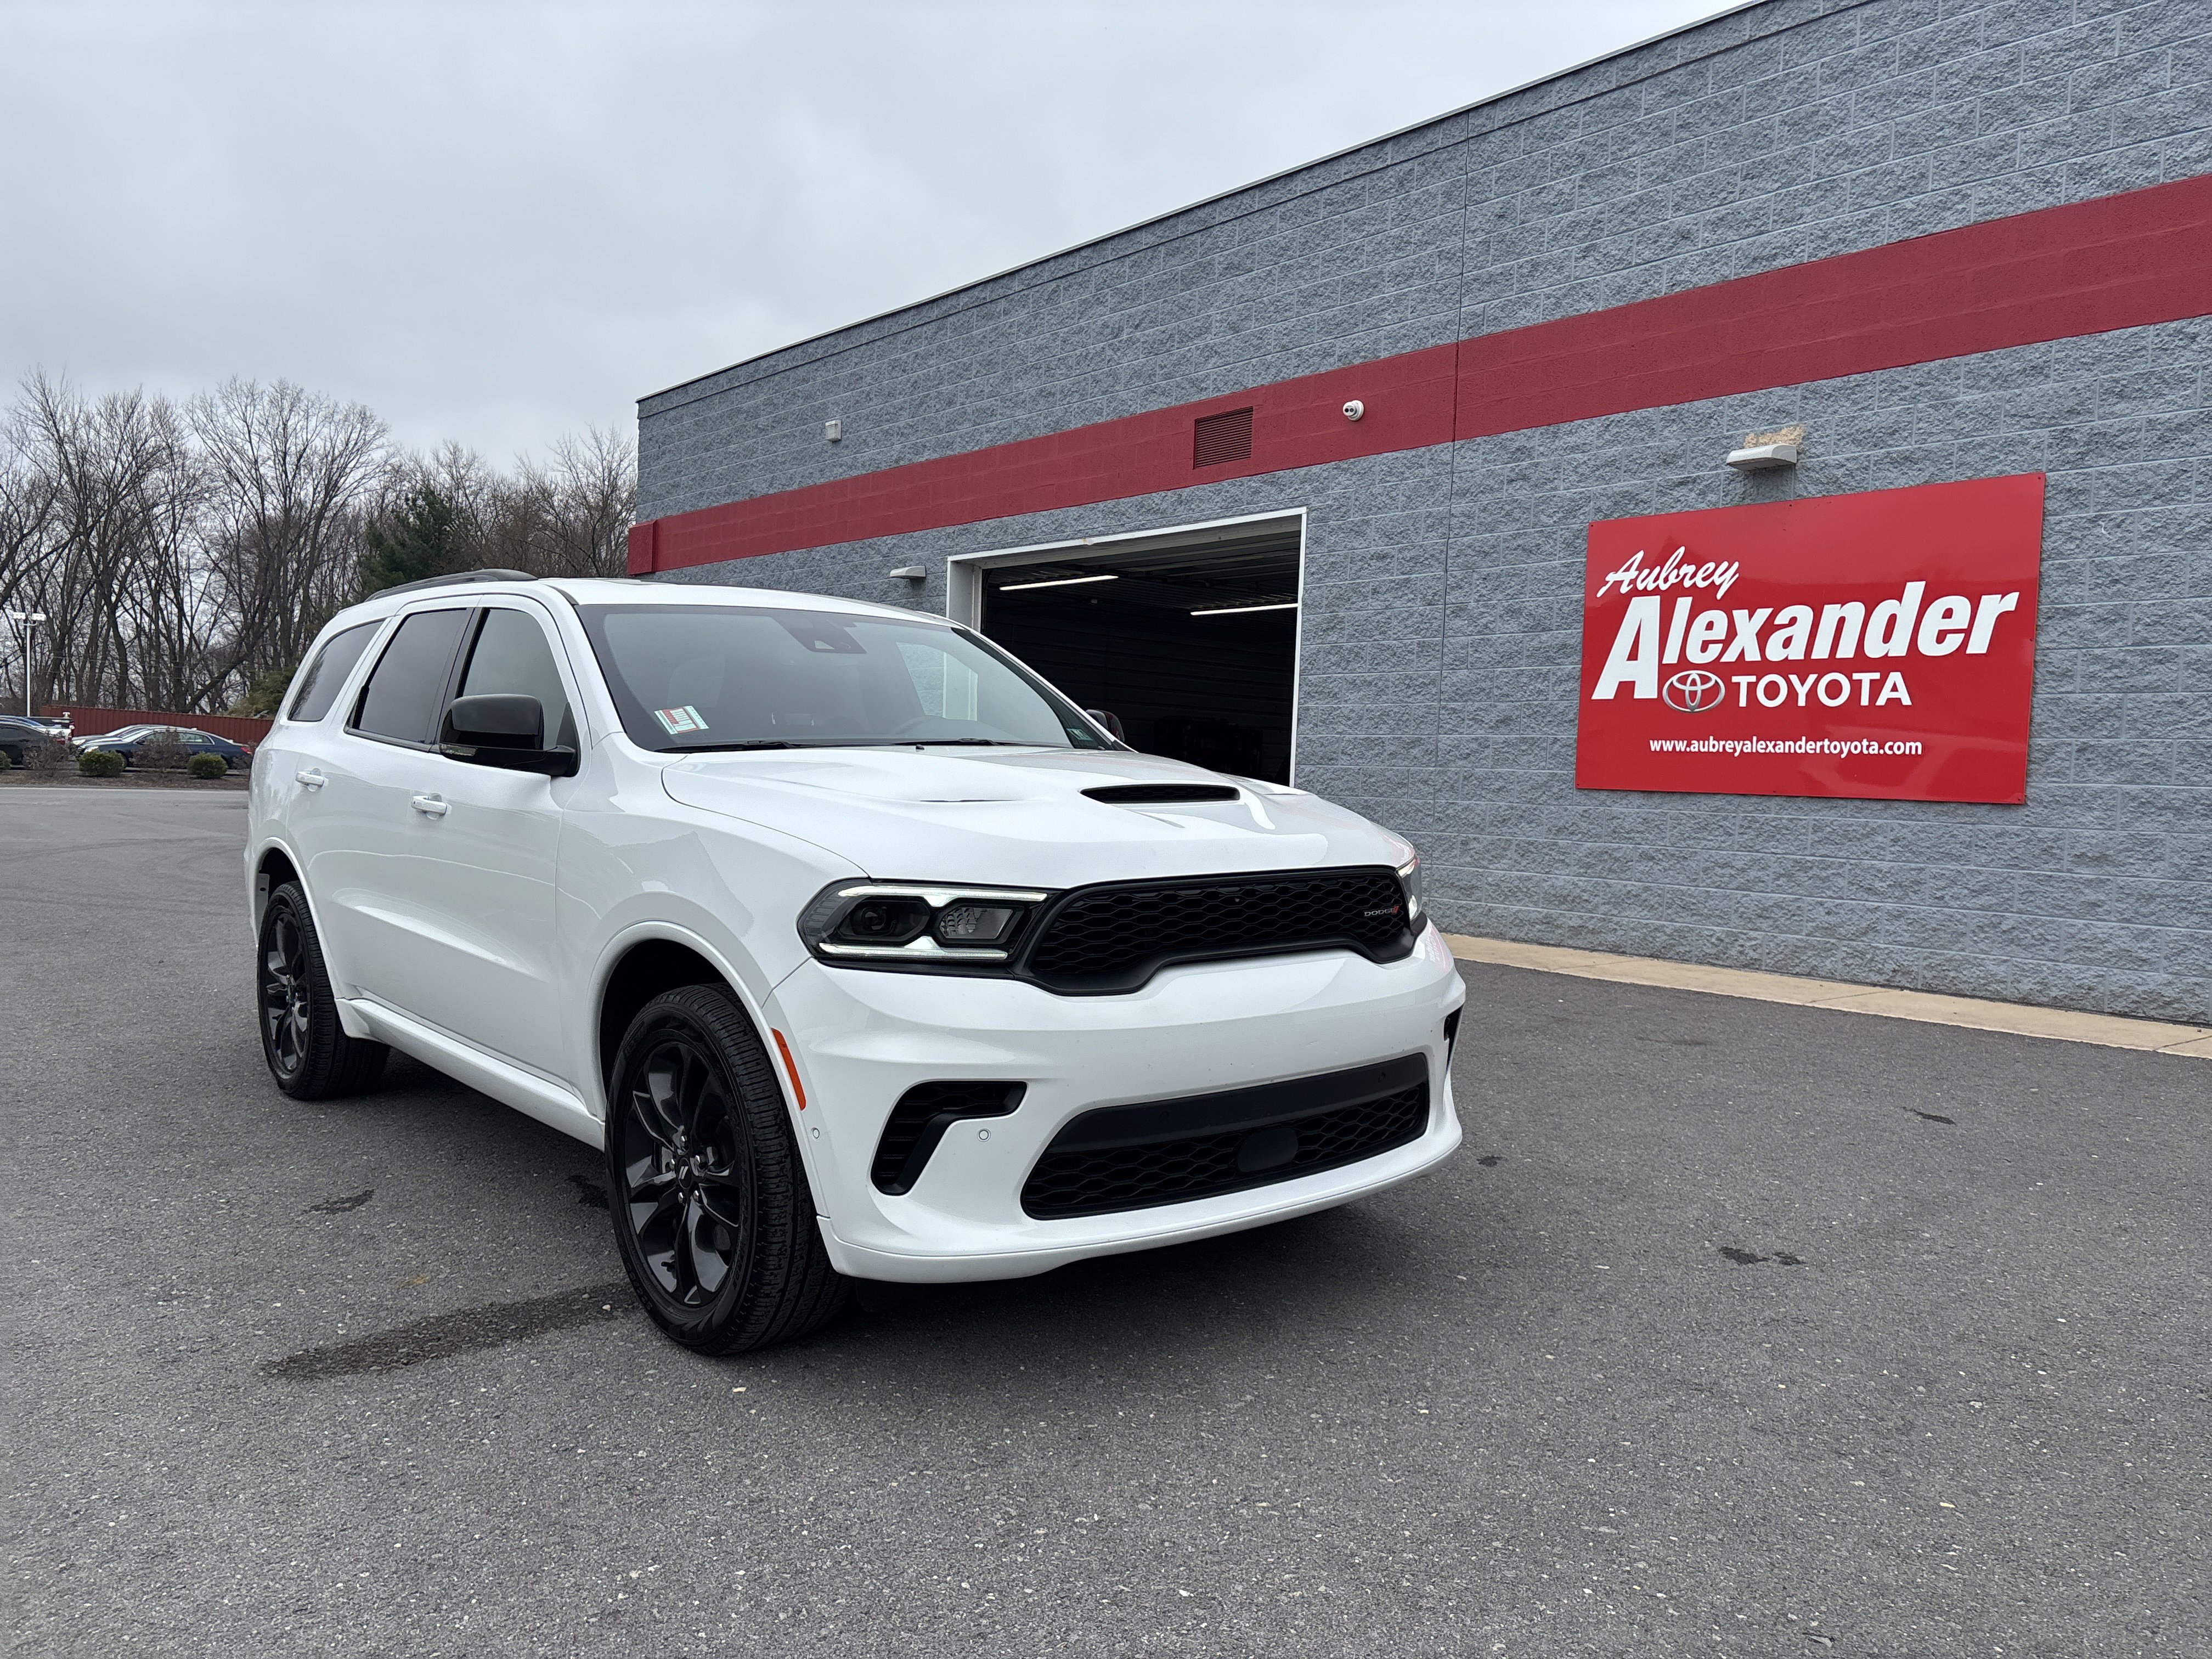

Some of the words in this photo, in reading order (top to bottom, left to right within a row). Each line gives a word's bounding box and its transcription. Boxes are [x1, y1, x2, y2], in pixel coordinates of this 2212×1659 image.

[1596, 546, 1739, 600] Aubrey
[1592, 581, 2019, 699] Alexander
[1731, 672, 1912, 707] TOYOTA
[1649, 735, 1922, 758] www.aubreyalexandertoyota.com
[1364, 908, 1395, 917] DODGE
